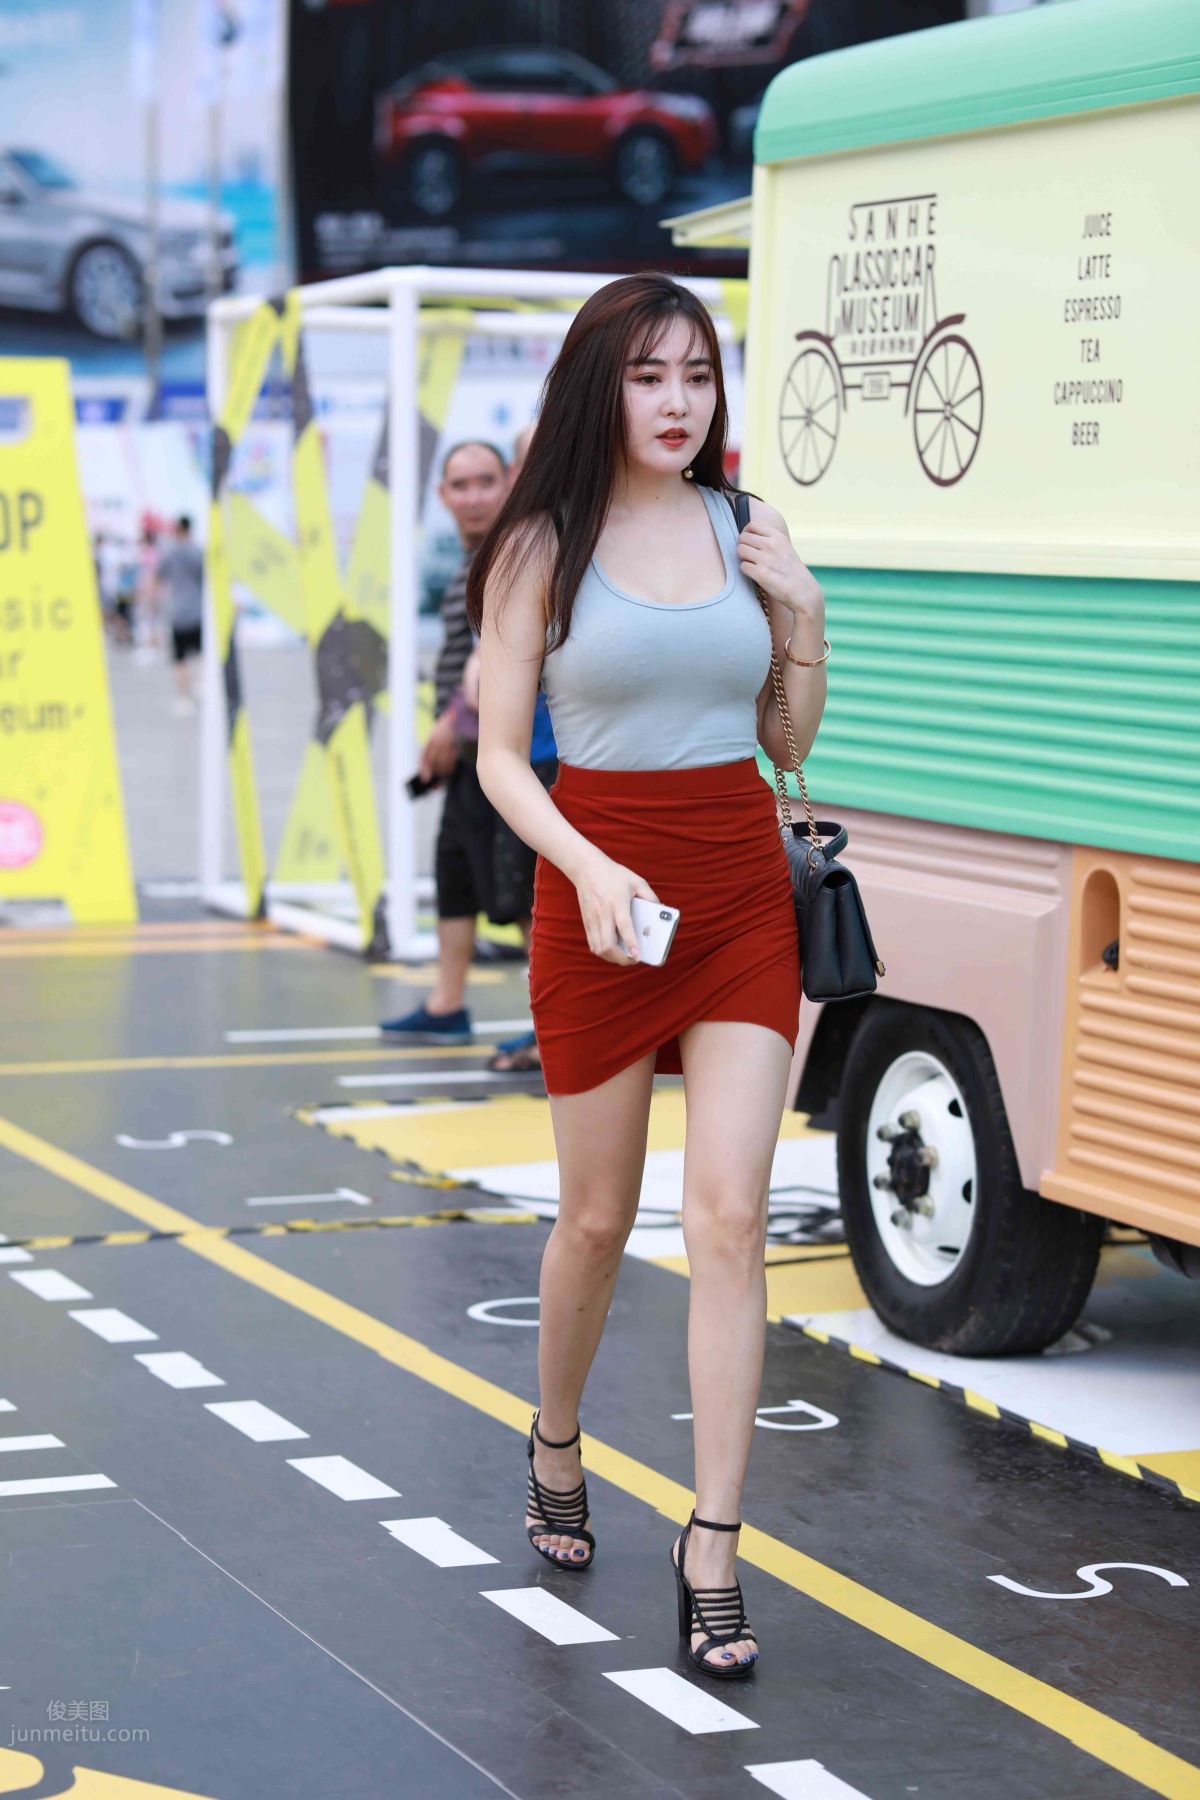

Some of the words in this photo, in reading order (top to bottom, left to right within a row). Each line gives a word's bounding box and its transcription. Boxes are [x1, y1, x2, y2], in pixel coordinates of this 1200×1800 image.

[848, 198, 938, 242] SANHE
[1082, 212, 1113, 239] JUICE
[1077, 254, 1112, 281] LATTE
[836, 293, 919, 336] MUSEUM
[1064, 295, 1122, 323] ESPRESSO
[1080, 338, 1101, 363] TEA
[1053, 379, 1124, 405] CAPPUCCINO
[1072, 422, 1100, 446] BEER
